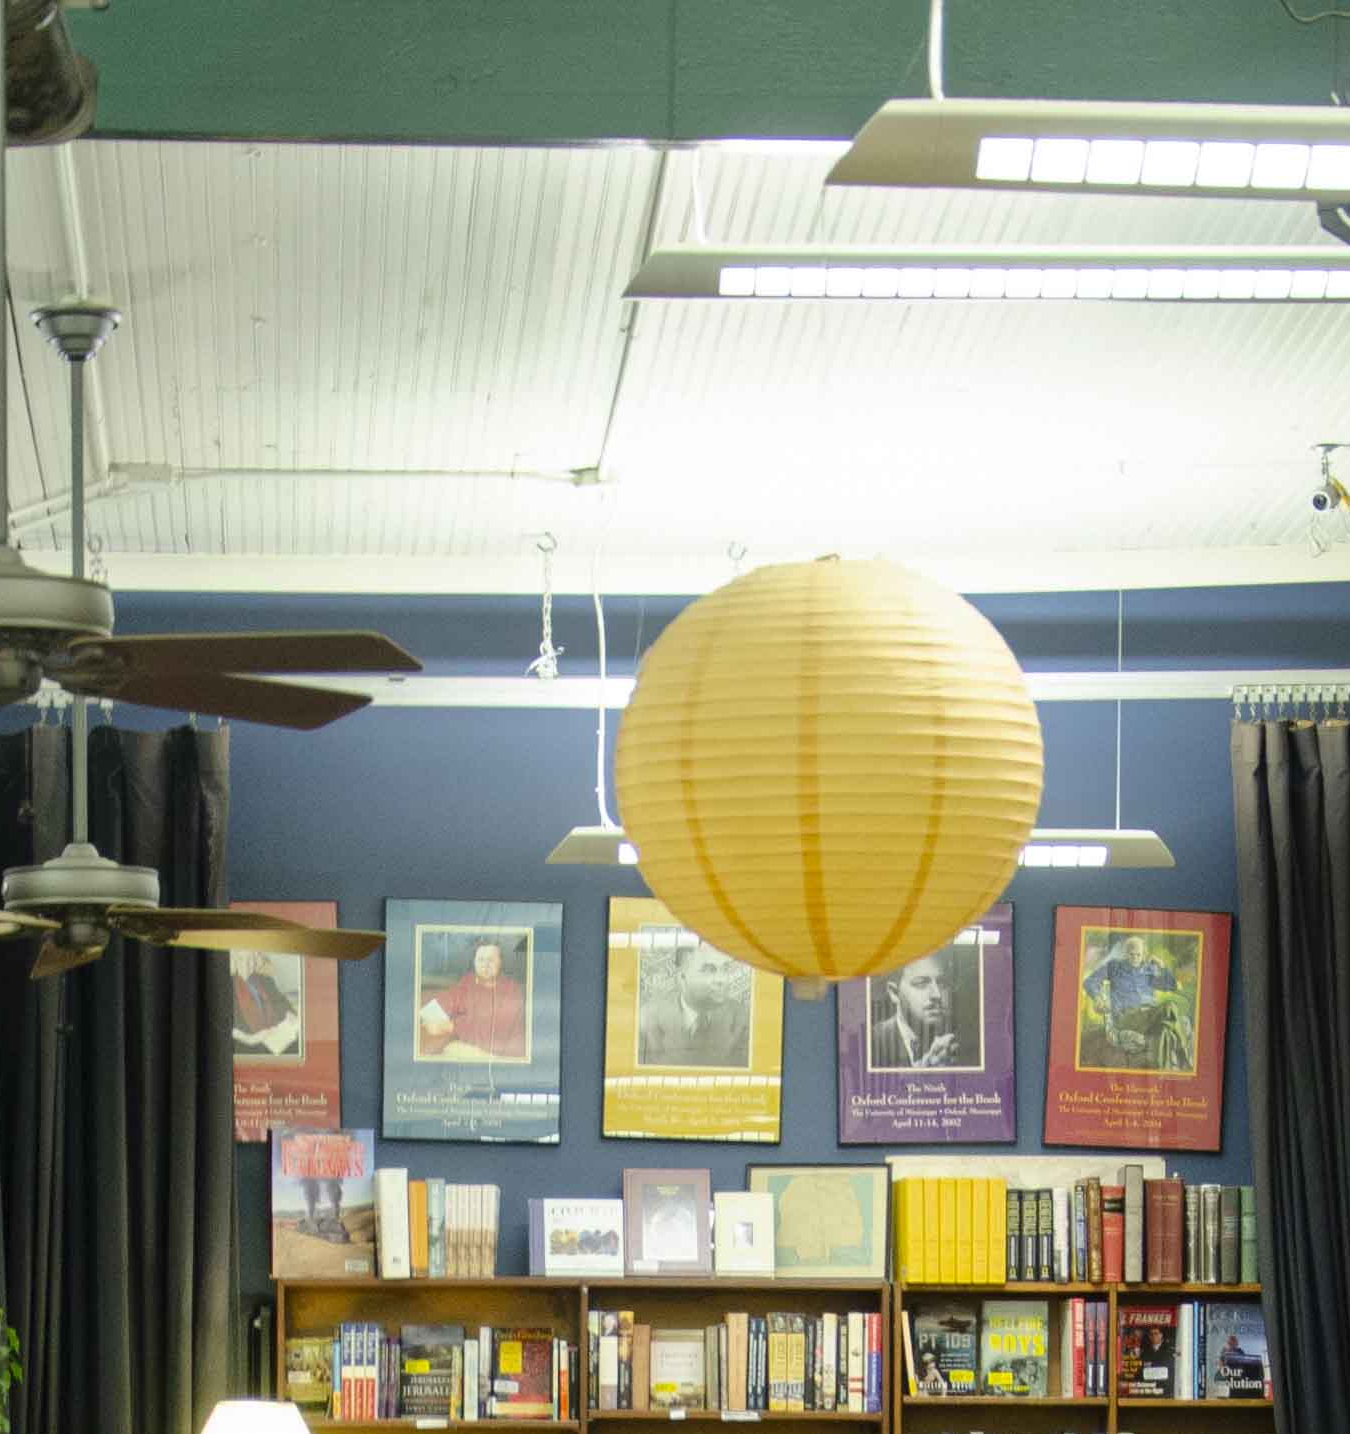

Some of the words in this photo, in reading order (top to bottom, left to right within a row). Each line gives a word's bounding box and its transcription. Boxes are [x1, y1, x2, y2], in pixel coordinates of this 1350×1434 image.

[851, 1093, 886, 1106] Oxford
[888, 1094, 942, 1106] Conference
[943, 1093, 957, 1106] for
[959, 1093, 974, 1106] the
[976, 1093, 1002, 1105] Book
[919, 1333, 937, 1349] PT
[944, 1333, 970, 1349] 109
[1220, 1367, 1244, 1378] Our
